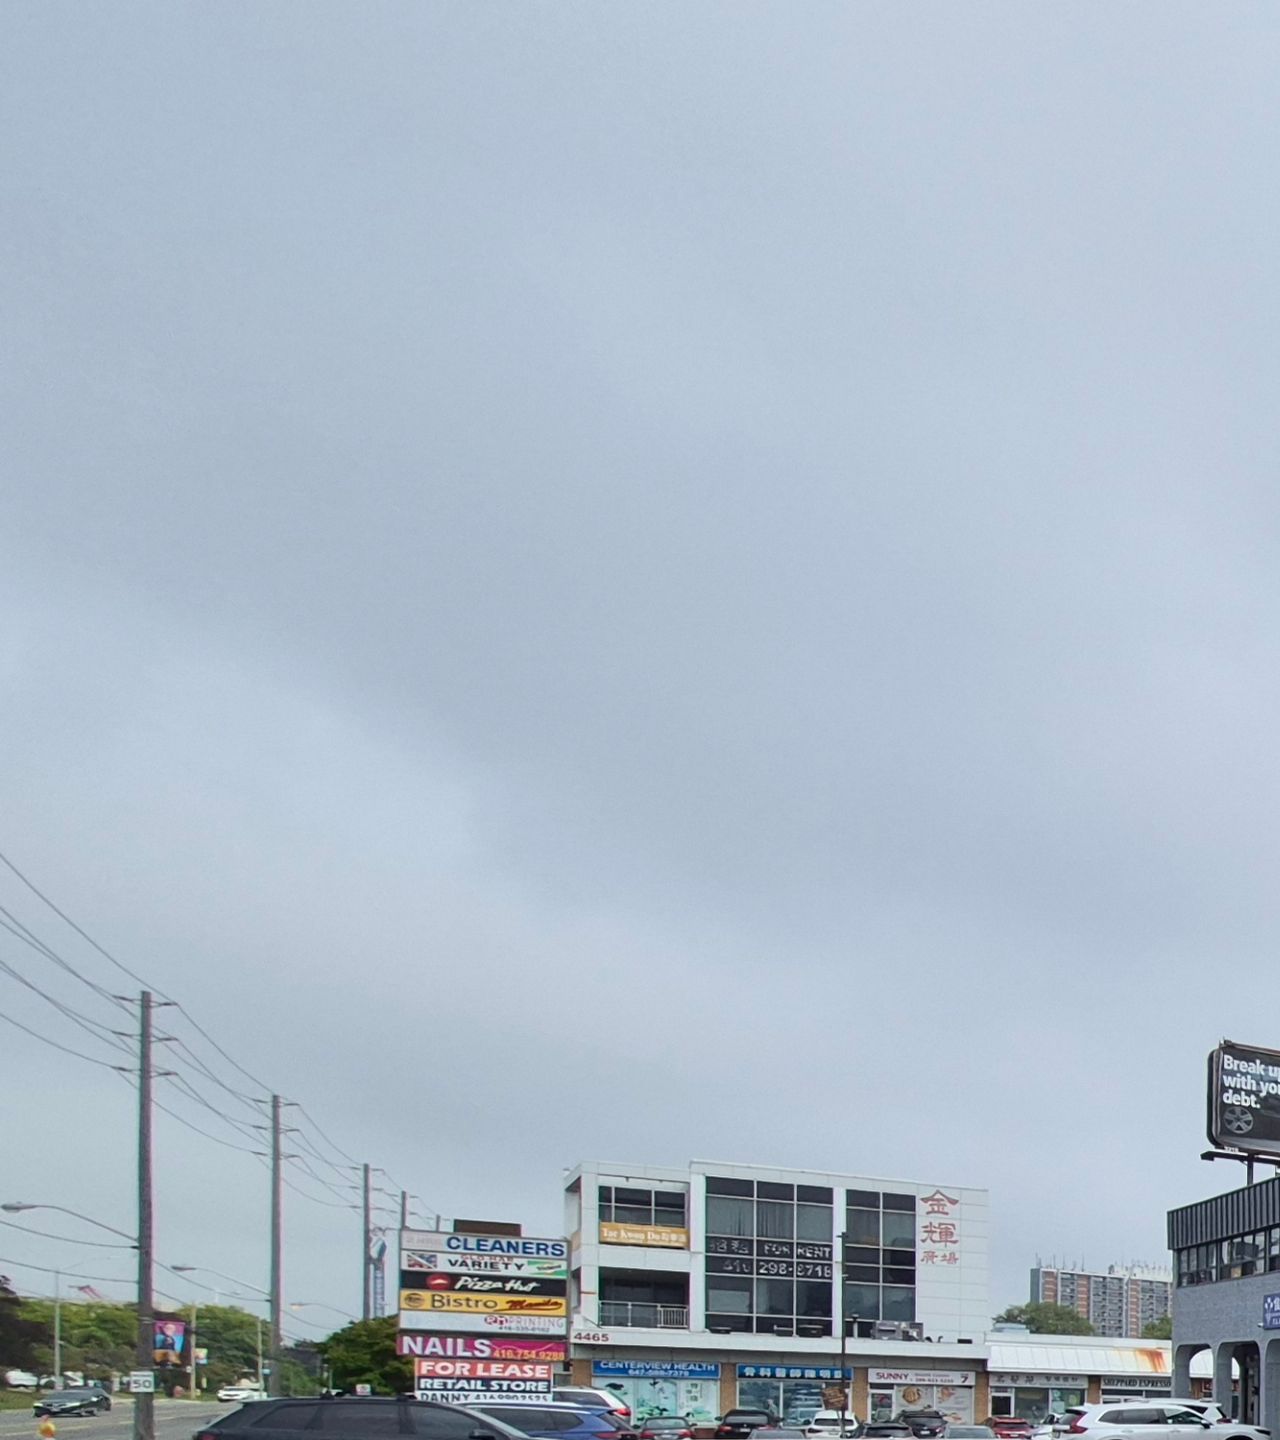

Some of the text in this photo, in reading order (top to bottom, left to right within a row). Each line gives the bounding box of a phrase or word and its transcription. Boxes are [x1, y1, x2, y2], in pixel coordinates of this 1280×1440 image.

[1223, 1054, 1265, 1076] Break
[1223, 1074, 1256, 1091] with
[1223, 1089, 1260, 1108] debt.
[446, 1236, 565, 1257] CLEANERS
[797, 1245, 832, 1258] RENT
[448, 1259, 525, 1271] VARIETY
[454, 1276, 540, 1292] Pizza Hut
[431, 1293, 498, 1309] Bistro
[509, 1316, 563, 1328] PRINTING
[574, 1332, 609, 1342] 4465
[402, 1336, 493, 1357] NAILS
[420, 1361, 549, 1378] FOR LEASE
[600, 1361, 715, 1372] CENTERVIEW HEALTH
[133, 1379, 152, 1389] 50
[420, 1378, 549, 1392] RETAIL STORE
[876, 1372, 910, 1381] SUNNY
[960, 1375, 970, 1384] 7
[1103, 1377, 1137, 1387] SHEPPARD
